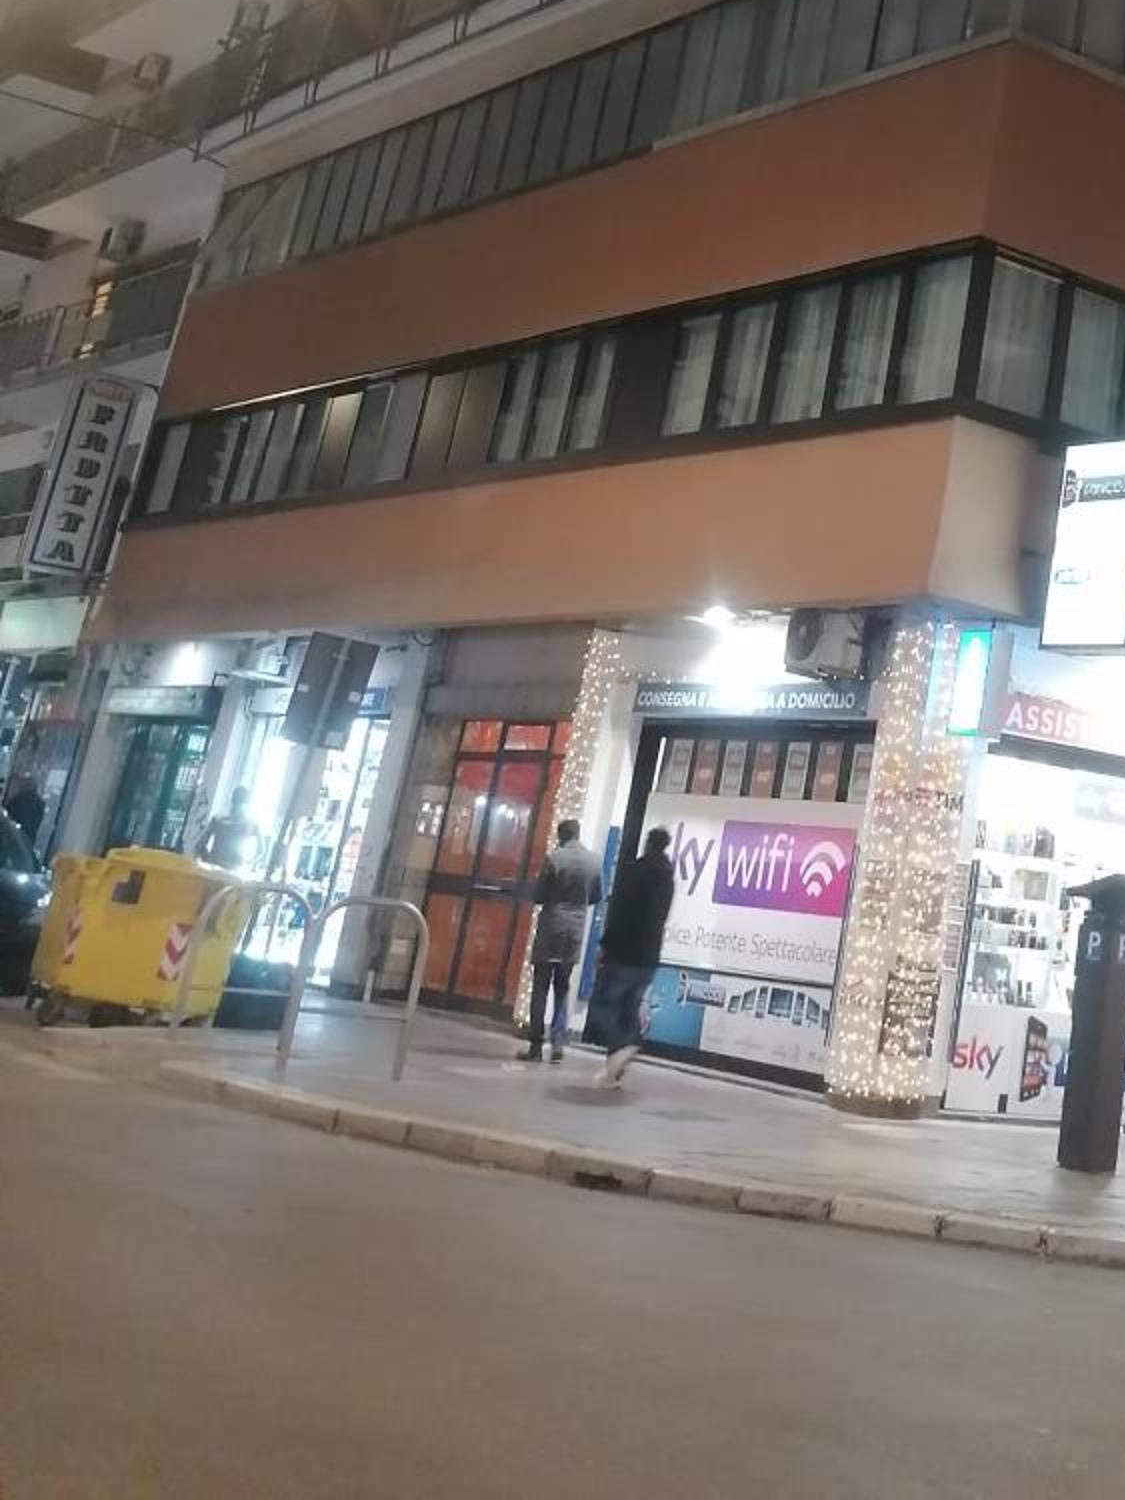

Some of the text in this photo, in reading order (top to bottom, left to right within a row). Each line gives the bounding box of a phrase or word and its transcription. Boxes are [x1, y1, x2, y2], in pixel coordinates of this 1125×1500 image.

[789, 692, 855, 709] DOMICILIO
[671, 821, 795, 896] ky wifi
[695, 925, 747, 955] Potente
[750, 932, 836, 966] Spettacolare
[1088, 931, 1101, 956] P
[951, 1036, 1004, 1080] sky
